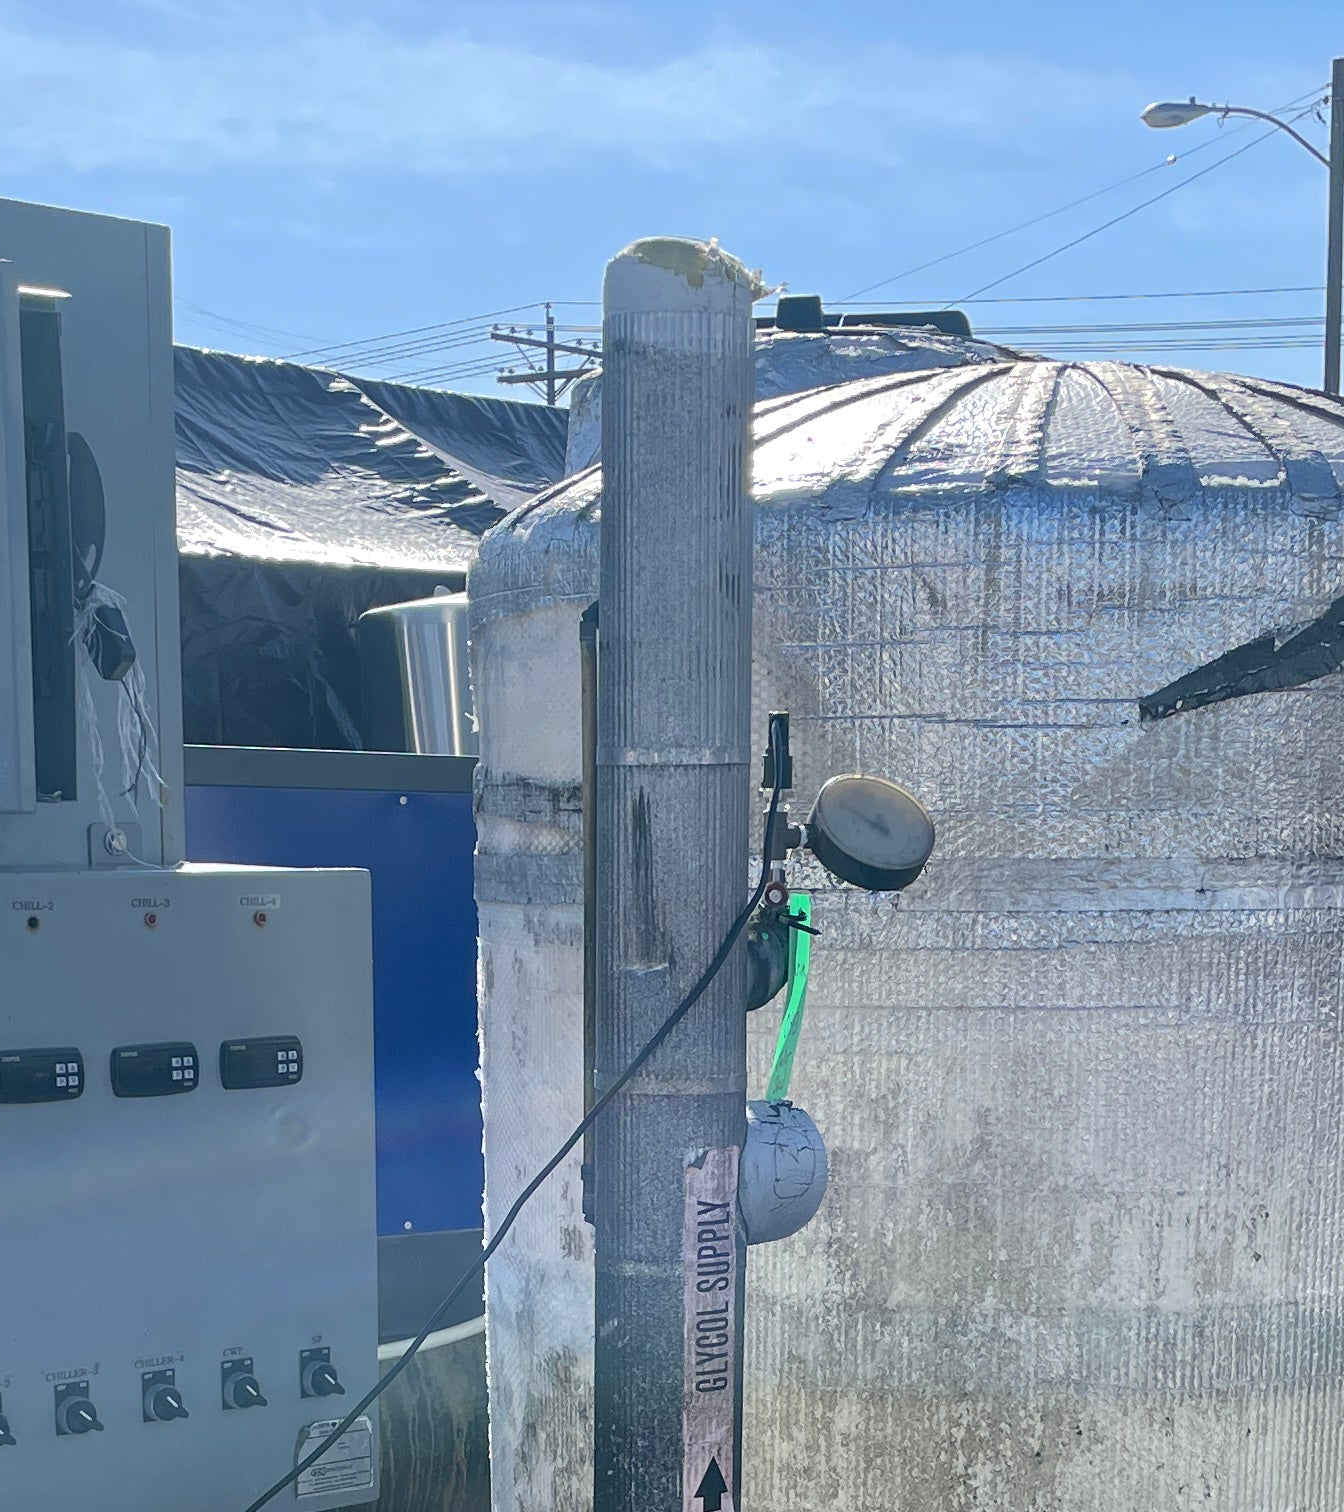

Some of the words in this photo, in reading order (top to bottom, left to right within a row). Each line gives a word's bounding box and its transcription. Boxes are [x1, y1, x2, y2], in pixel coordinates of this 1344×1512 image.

[11, 900, 54, 911] CHILL-2
[130, 898, 171, 908] CHILL-3
[696, 1200, 731, 1294] SUPPLY
[694, 1299, 730, 1394] GLYCOL
[134, 1354, 185, 1369] CHILLER-4
